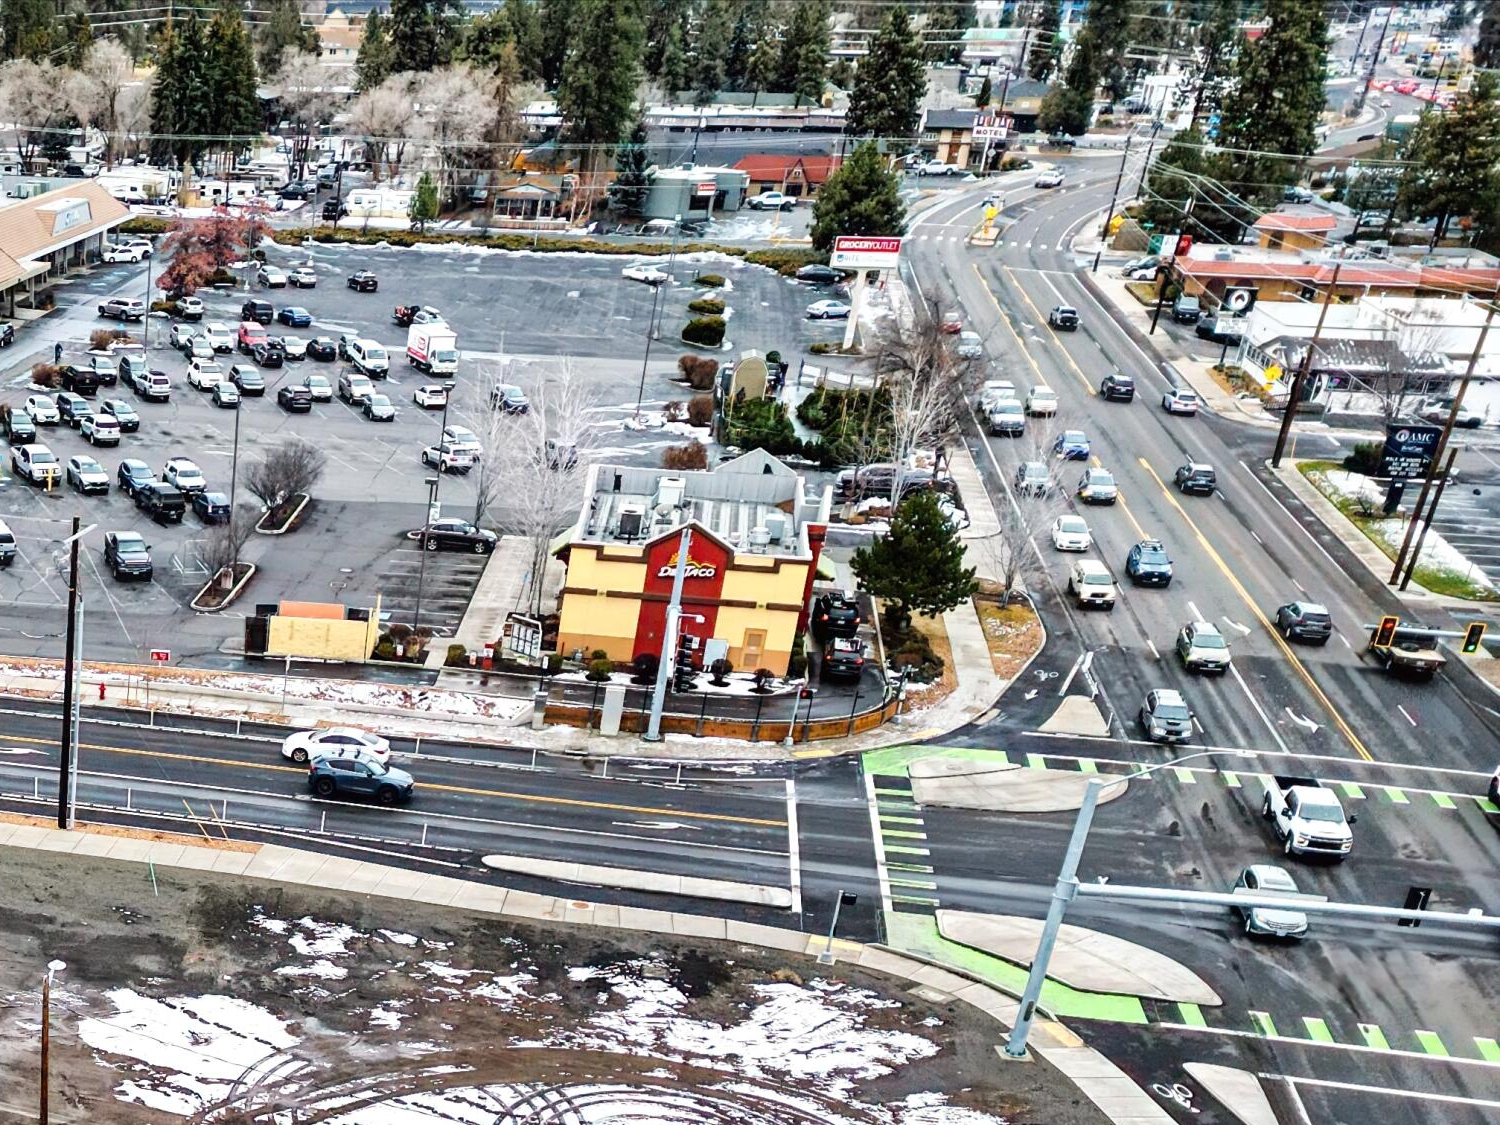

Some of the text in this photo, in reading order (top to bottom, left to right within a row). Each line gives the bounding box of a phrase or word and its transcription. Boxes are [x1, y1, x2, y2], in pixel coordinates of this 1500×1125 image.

[975, 129, 1004, 137] MOTEL
[1408, 432, 1434, 442] AMC
[684, 566, 715, 577] TACO
